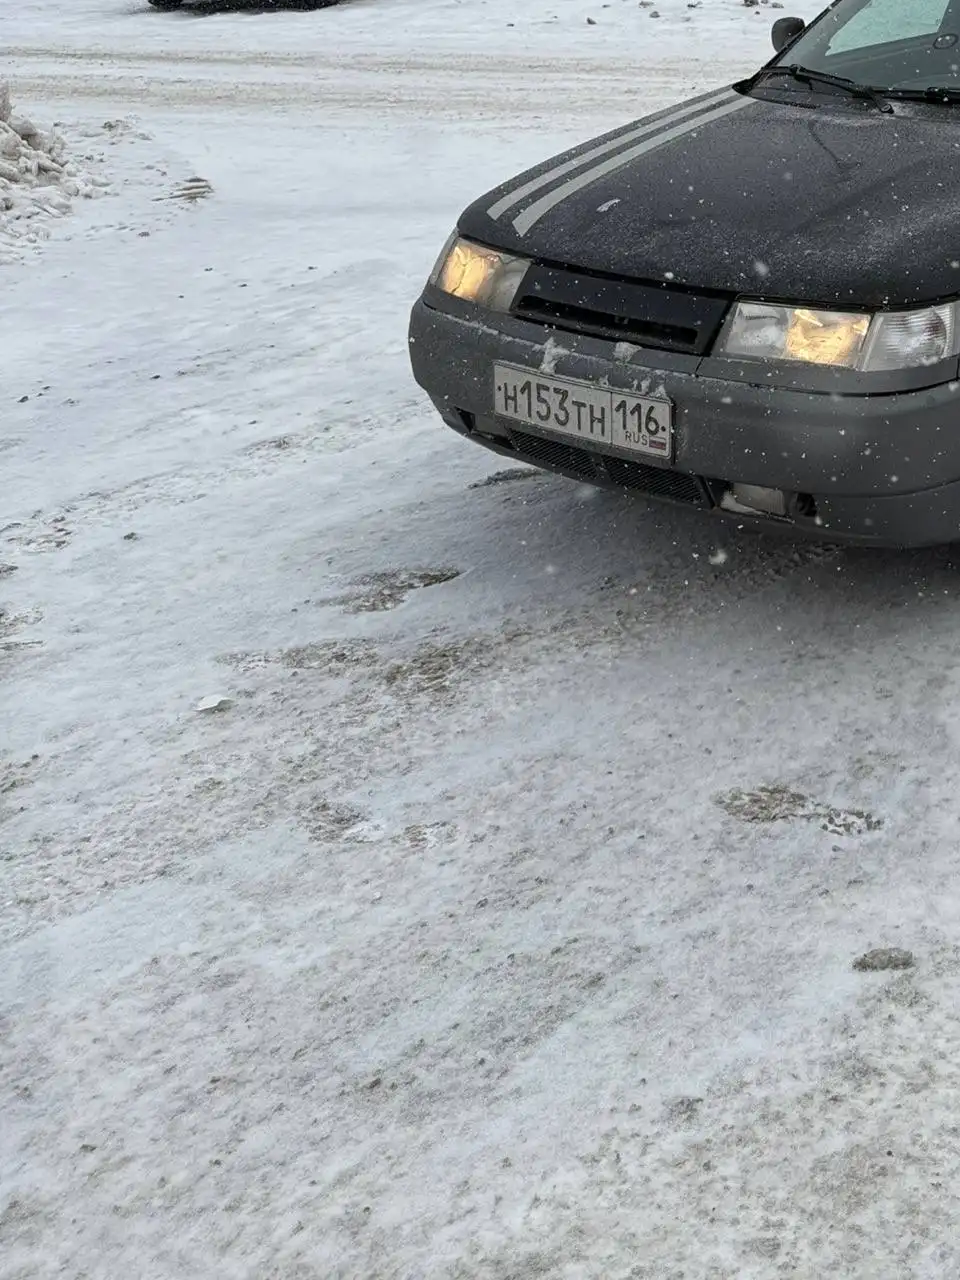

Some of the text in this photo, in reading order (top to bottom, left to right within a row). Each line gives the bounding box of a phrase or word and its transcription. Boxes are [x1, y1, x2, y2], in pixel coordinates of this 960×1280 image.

[503, 380, 660, 437] Н153ТН 116
[625, 431, 648, 446] RUS
